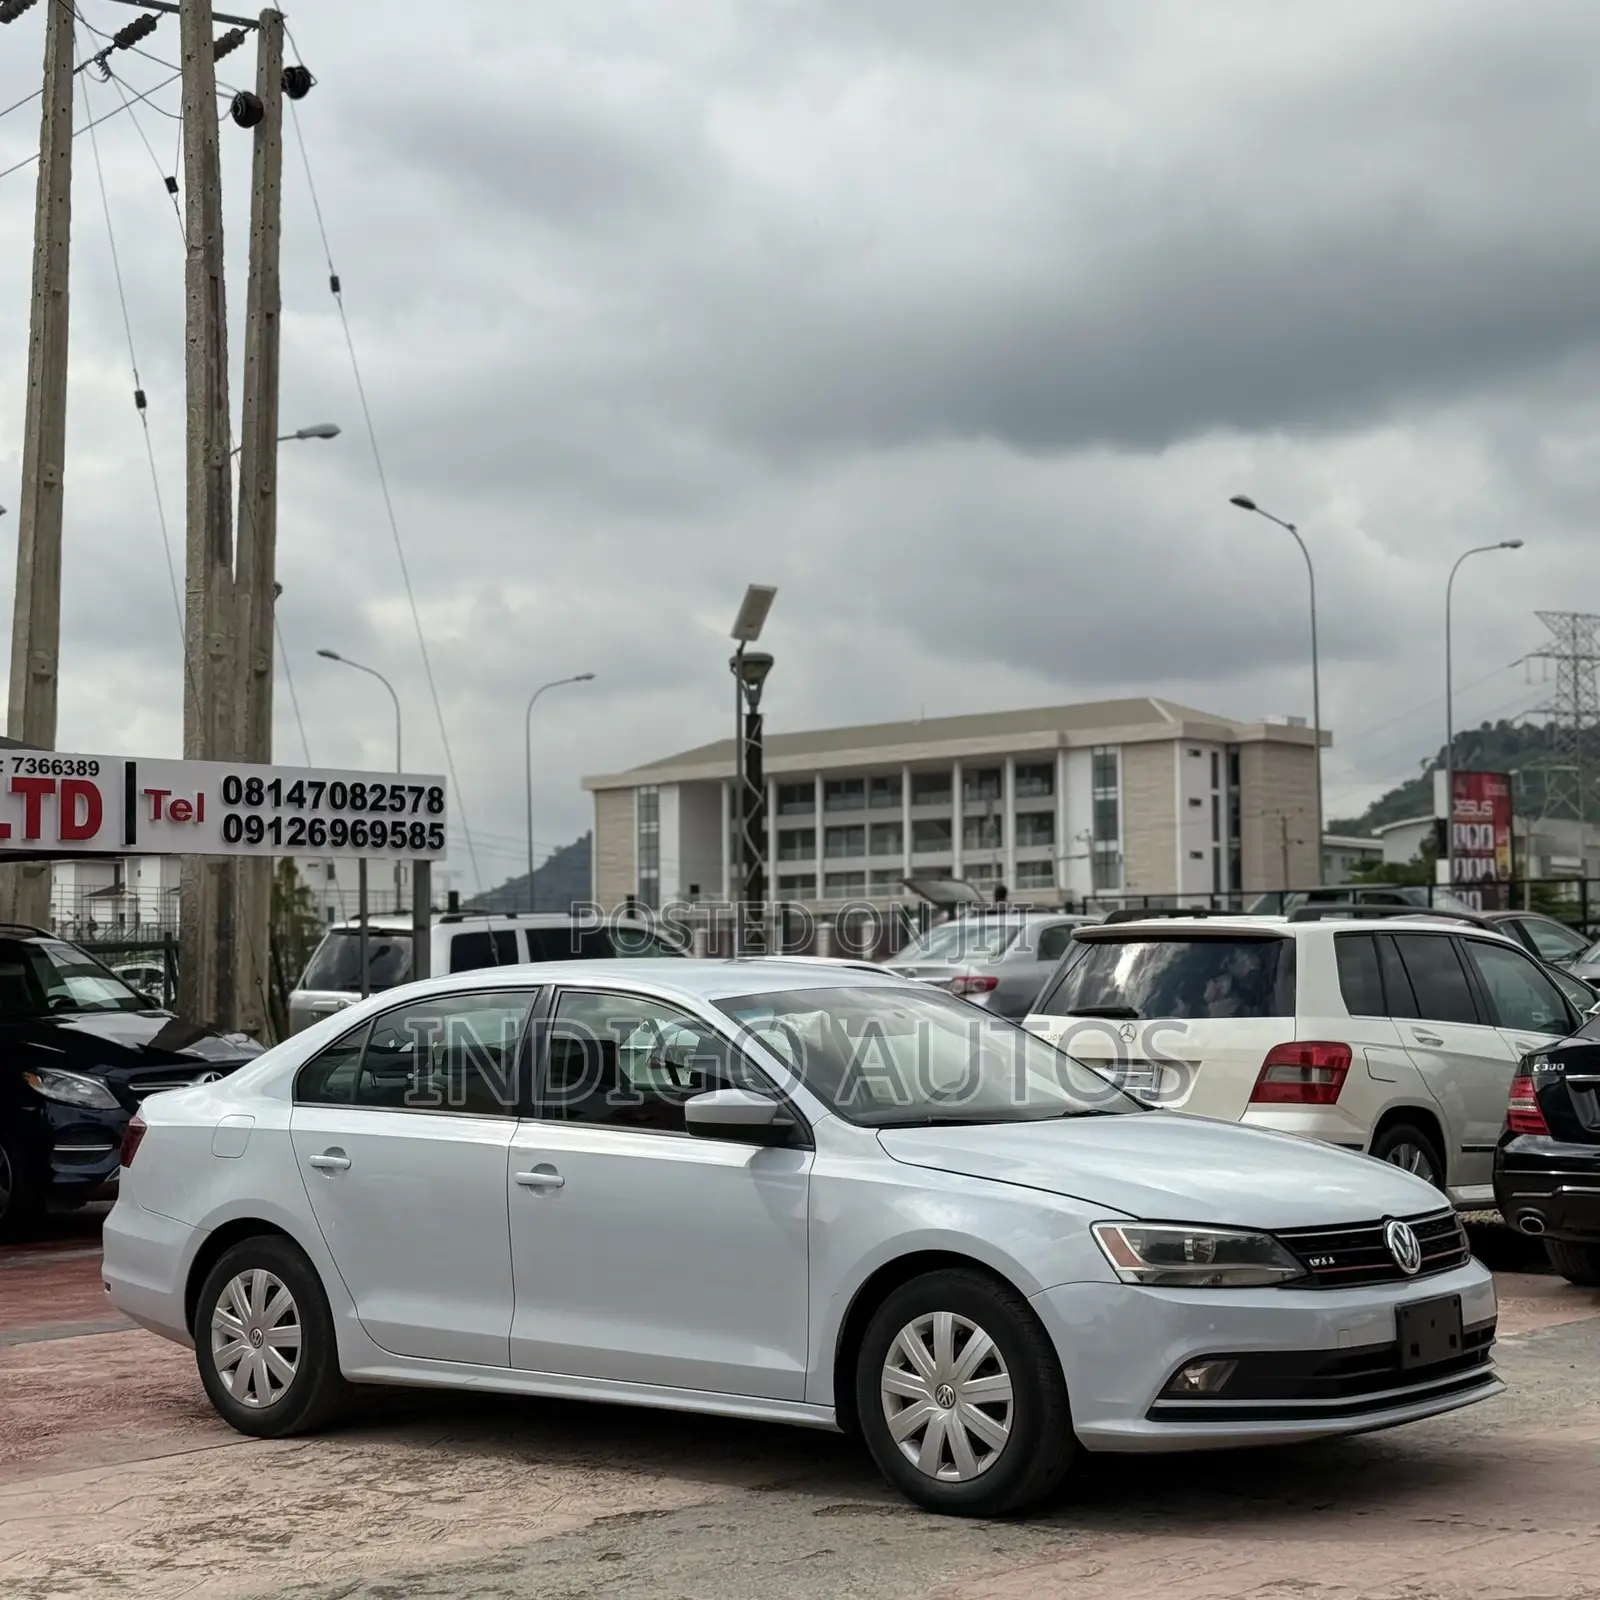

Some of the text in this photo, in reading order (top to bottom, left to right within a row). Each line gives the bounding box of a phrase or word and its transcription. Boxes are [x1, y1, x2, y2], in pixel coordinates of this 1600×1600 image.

[11, 757, 100, 777] 7366389
[0, 777, 103, 840] TD
[144, 788, 205, 823] Tel
[222, 775, 444, 814] 08147082578
[223, 813, 445, 850] 09126969585
